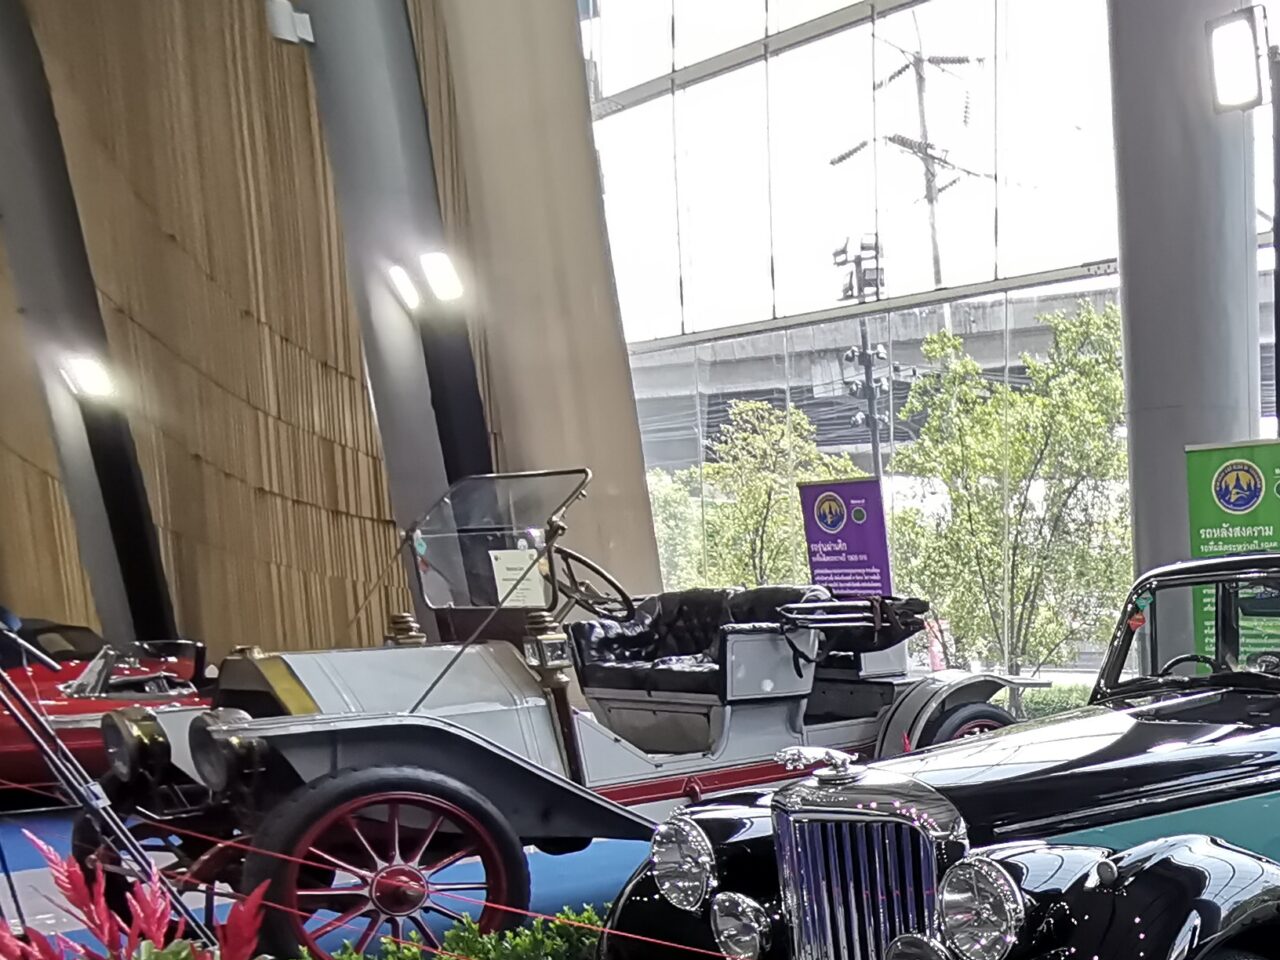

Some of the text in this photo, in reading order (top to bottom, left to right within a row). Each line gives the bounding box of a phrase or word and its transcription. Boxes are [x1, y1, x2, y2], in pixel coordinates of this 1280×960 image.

[1199, 522, 1274, 539] รถหลังสงคราม
